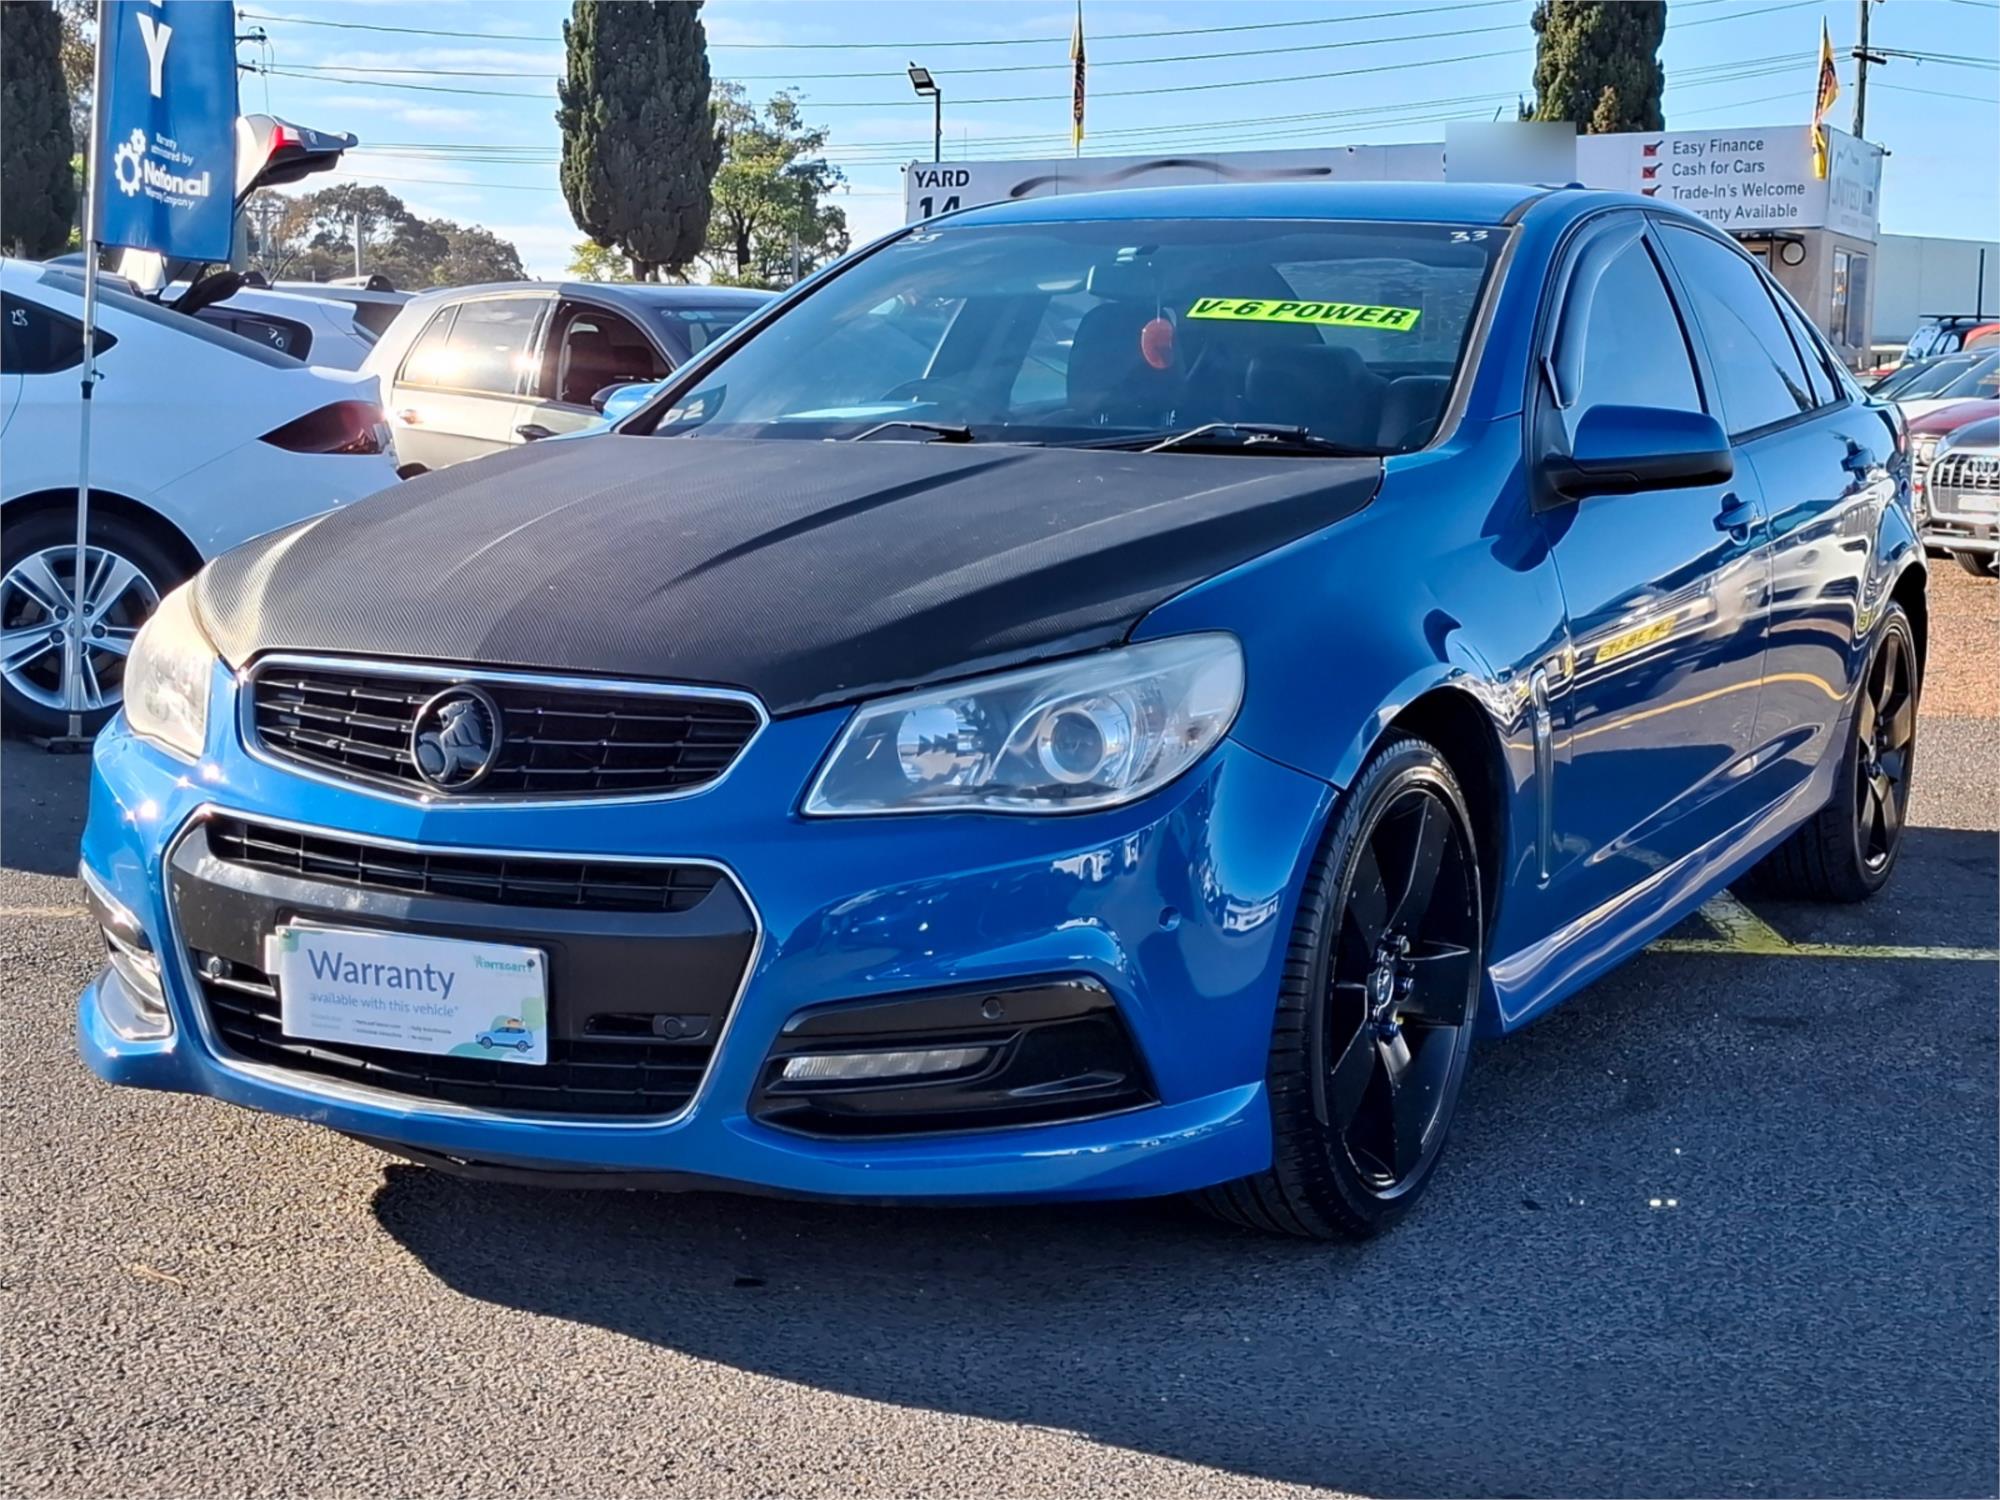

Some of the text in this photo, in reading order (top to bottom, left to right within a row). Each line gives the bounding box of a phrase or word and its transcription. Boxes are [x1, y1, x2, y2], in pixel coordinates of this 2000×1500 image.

[136, 0, 173, 98] Y
[1672, 139, 1764, 157] Easy Finance
[1672, 159, 1765, 176] Cash for Cars
[914, 170, 970, 188] YARD
[1672, 182, 1806, 199] Trade-In's Welcome
[1734, 203, 1798, 219] Available
[1450, 230, 1489, 243] 33
[1195, 299, 1411, 325] V-6 POWER
[308, 949, 455, 1000] Warranty
[310, 992, 359, 1008] available
[360, 997, 387, 1011] with
[389, 1000, 411, 1014] this
